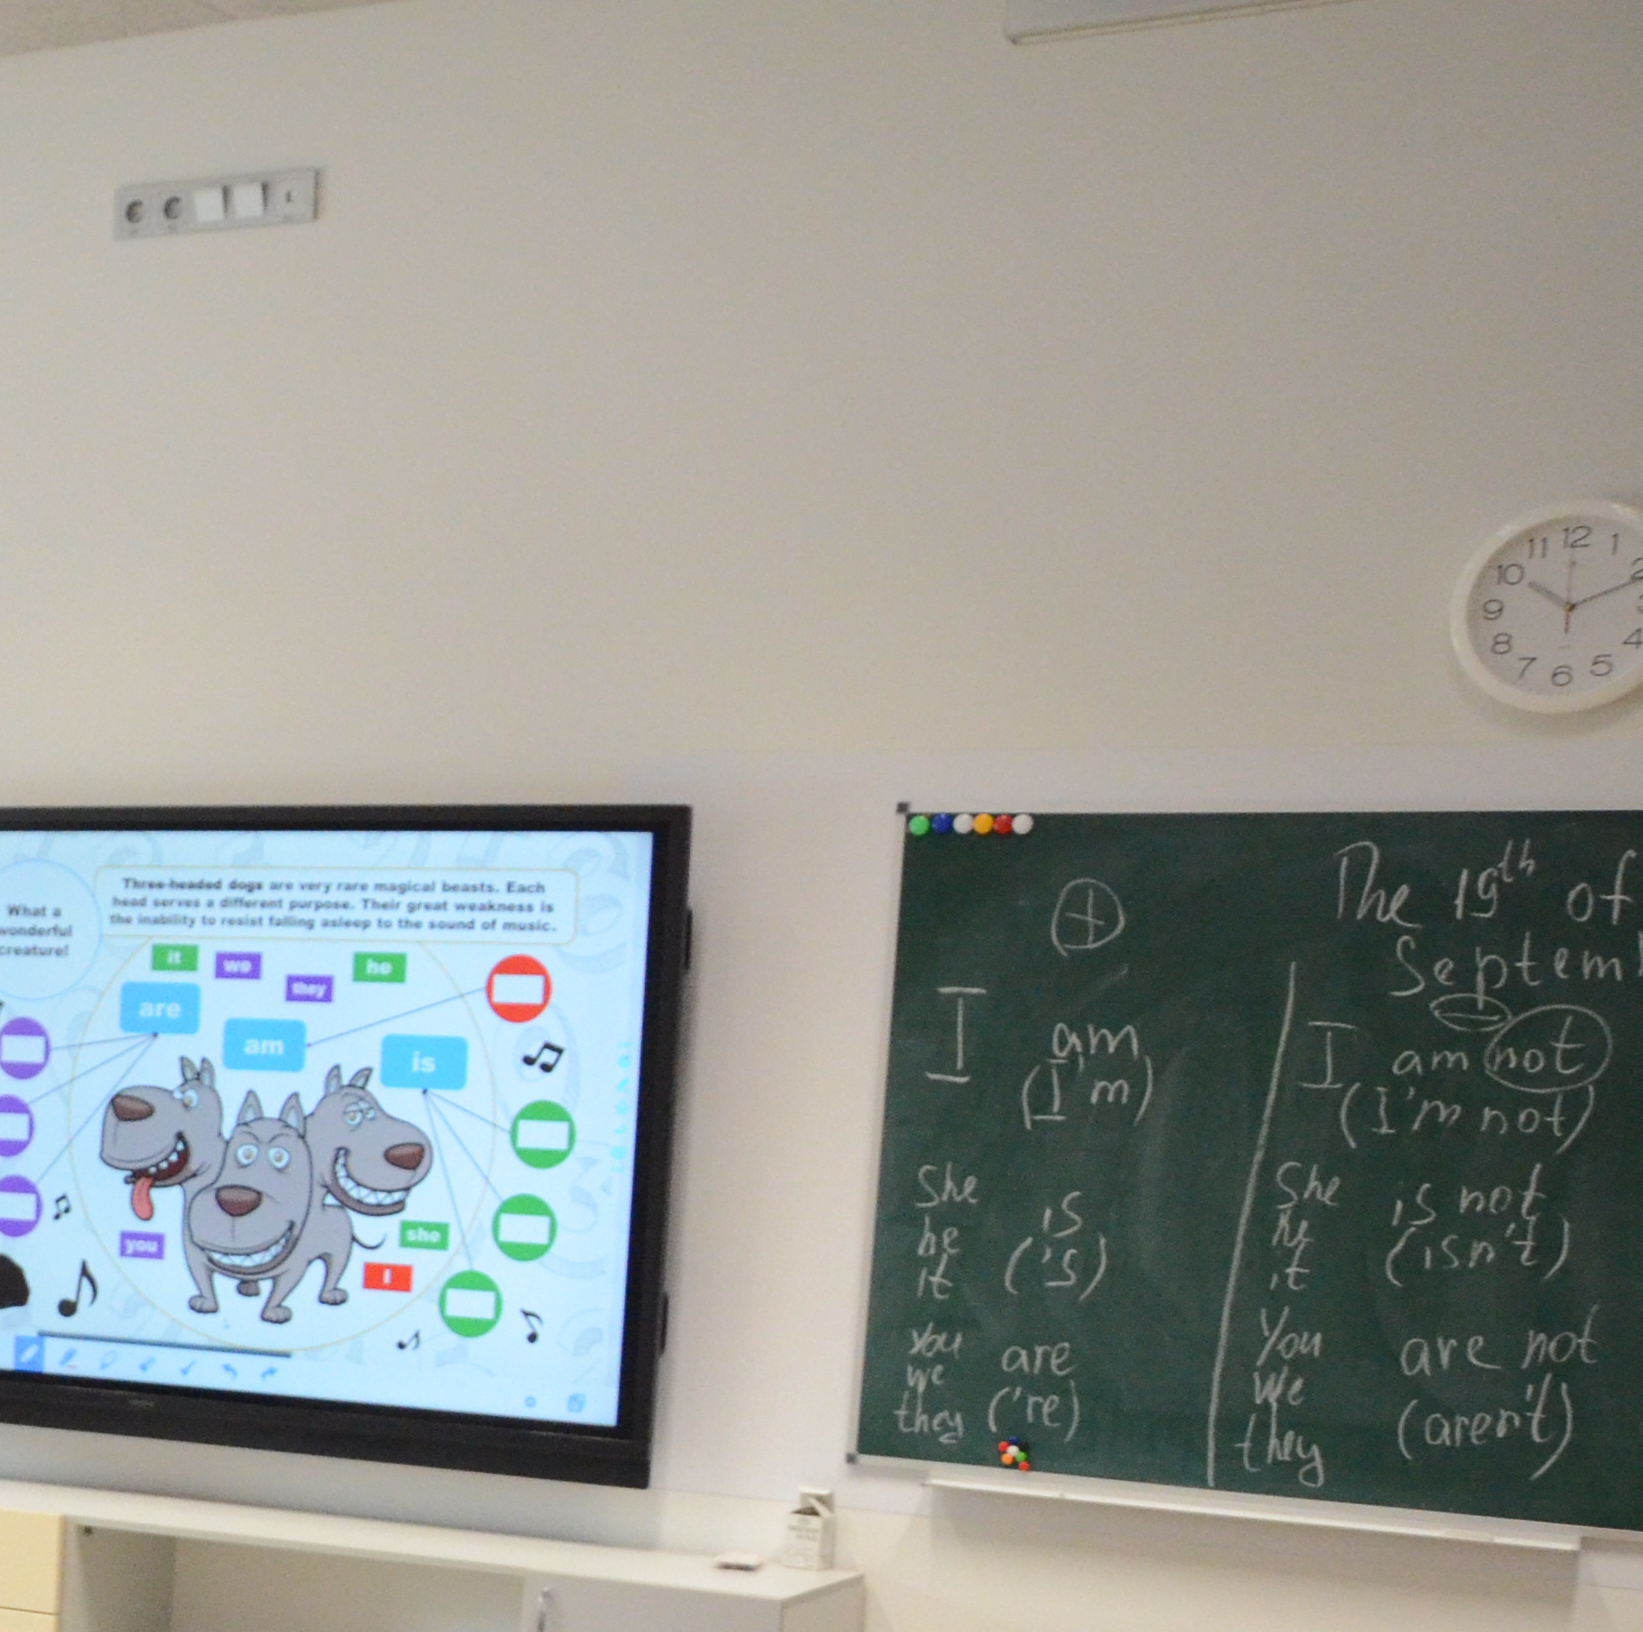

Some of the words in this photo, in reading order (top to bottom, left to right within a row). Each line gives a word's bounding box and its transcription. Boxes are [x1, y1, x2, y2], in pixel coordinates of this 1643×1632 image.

[1563, 525, 1591, 548] 12
[1612, 533, 1619, 555] 1
[1528, 537, 1548, 558] 11
[1497, 563, 1525, 585] 10
[1482, 599, 1504, 620] 9
[1491, 632, 1512, 654] 8
[1518, 657, 1537, 679] 7
[1551, 665, 1573, 686] 6
[1590, 654, 1613, 676] 5
[123, 878, 222, 890] Three-headed
[229, 879, 262, 893] dogs
[270, 881, 293, 891] are
[300, 882, 331, 893] very
[337, 882, 368, 892] rare
[374, 881, 436, 895] magical
[442, 881, 499, 893] beasts.
[507, 881, 545, 893] Each
[1333, 841, 1422, 928] The
[1567, 849, 1637, 925] of
[7, 904, 48, 918] What
[52, 907, 62, 918] a
[113, 896, 147, 908] head
[154, 898, 200, 908] serves
[207, 899, 214, 908] a
[220, 896, 283, 909] different
[289, 899, 355, 912] purpose.
[362, 899, 400, 910] Their
[407, 901, 447, 913] great
[455, 901, 534, 913] weakness
[541, 902, 554, 913] is
[110, 914, 132, 924] the
[138, 914, 196, 927] inability
[202, 915, 215, 926] to
[221, 915, 263, 927] resist
[269, 915, 315, 929] falling
[321, 917, 371, 930] asleep
[378, 917, 392, 929] to
[398, 918, 422, 929] the
[428, 919, 475, 931] sound
[481, 919, 496, 930] of
[503, 920, 556, 932] music.
[167, 950, 182, 964] it
[223, 960, 252, 974] we
[366, 958, 392, 976] he
[291, 981, 327, 999] they
[139, 1001, 182, 1019] are
[925, 986, 987, 1083] I
[1053, 1022, 1139, 1059] am
[243, 1038, 285, 1056] am
[1299, 1021, 1359, 1088] I
[1392, 1050, 1468, 1076] am
[1492, 1015, 1586, 1075] not
[412, 1052, 436, 1073] is
[916, 1162, 977, 1208] She
[1043, 1191, 1083, 1237] is
[1276, 1161, 1340, 1208] She
[1392, 1183, 1437, 1225] is
[1459, 1163, 1546, 1221] not
[407, 1227, 441, 1243] she
[917, 1214, 960, 1256] he
[1272, 1209, 1313, 1247] he
[125, 1238, 158, 1255] you
[383, 1269, 391, 1284] I
[1402, 1335, 1501, 1376] are
[1522, 1305, 1599, 1369] not
[1001, 1342, 1077, 1376] are
[893, 1391, 963, 1444] they
[1235, 1406, 1325, 1487] they
